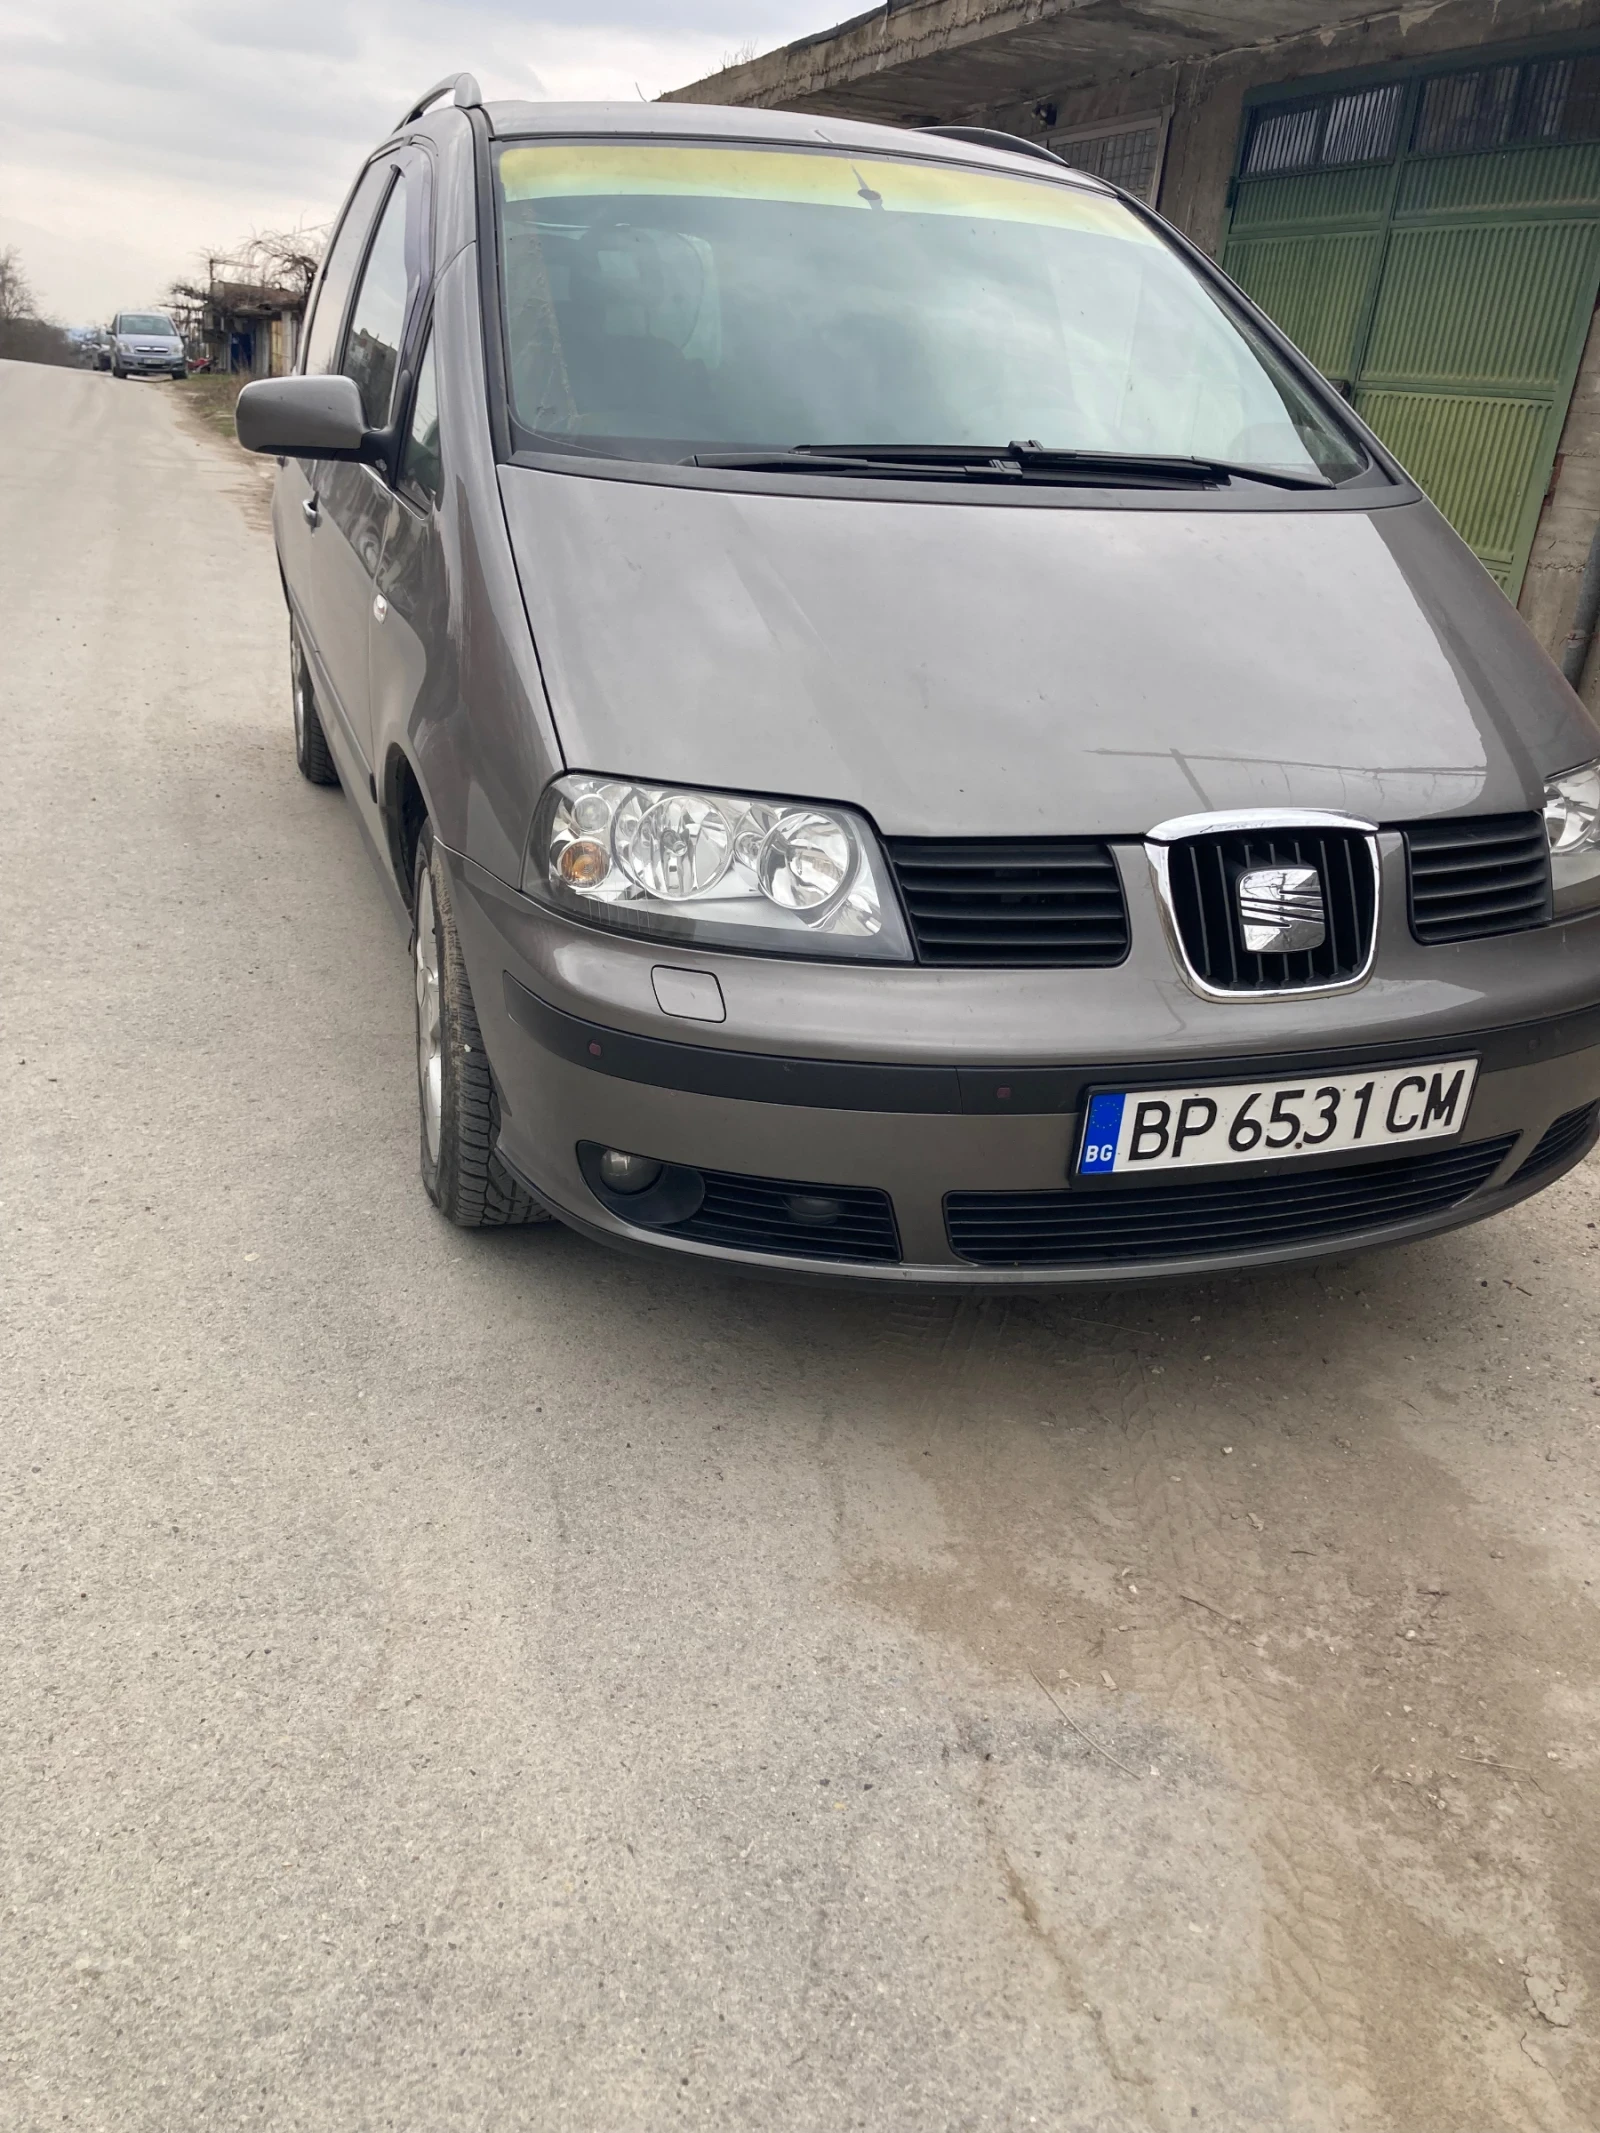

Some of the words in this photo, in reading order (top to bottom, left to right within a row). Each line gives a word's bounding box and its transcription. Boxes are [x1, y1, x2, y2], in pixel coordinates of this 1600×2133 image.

[1128, 1097, 1217, 1162] BP
[1228, 1081, 1375, 1152] 6531
[1385, 1069, 1466, 1134] CM
[1085, 1144, 1113, 1163] BG
